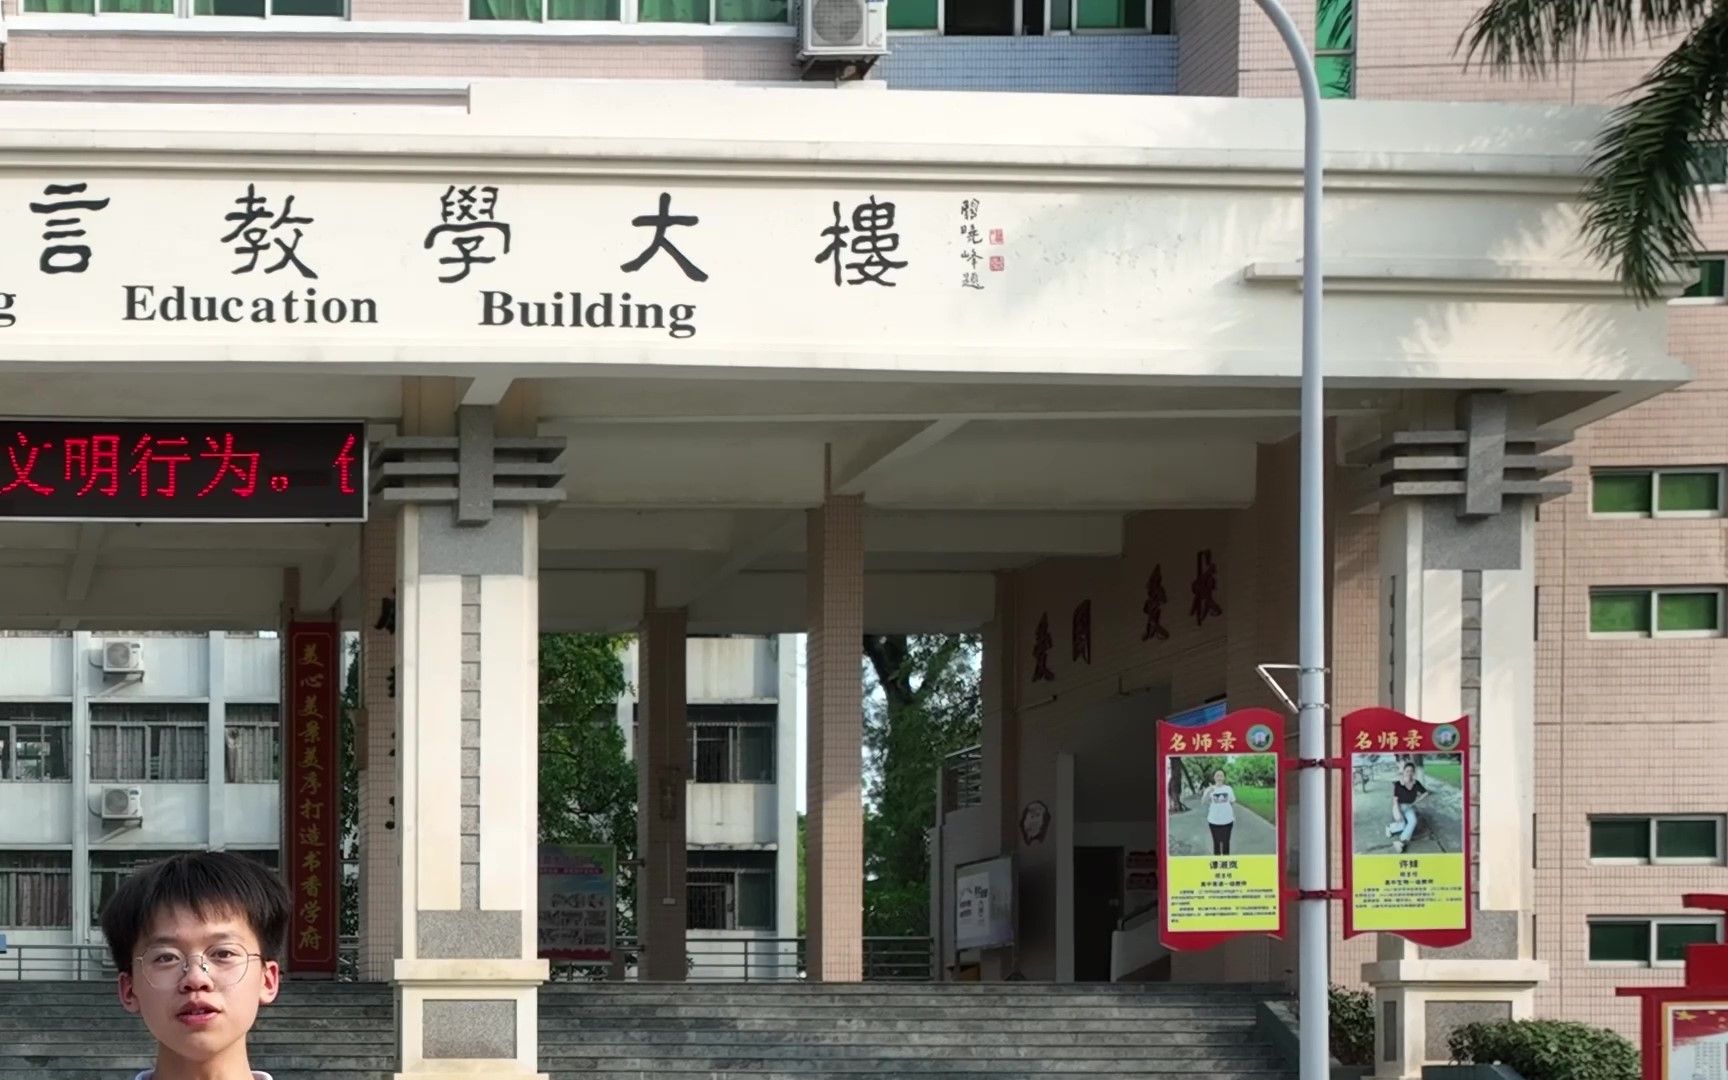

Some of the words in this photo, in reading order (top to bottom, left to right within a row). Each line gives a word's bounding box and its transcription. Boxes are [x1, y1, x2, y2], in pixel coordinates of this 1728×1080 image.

[123, 285, 378, 324] Education
[479, 291, 696, 339] Building
[1169, 730, 1237, 752] 名师录
[1354, 729, 1423, 750] 名师录
